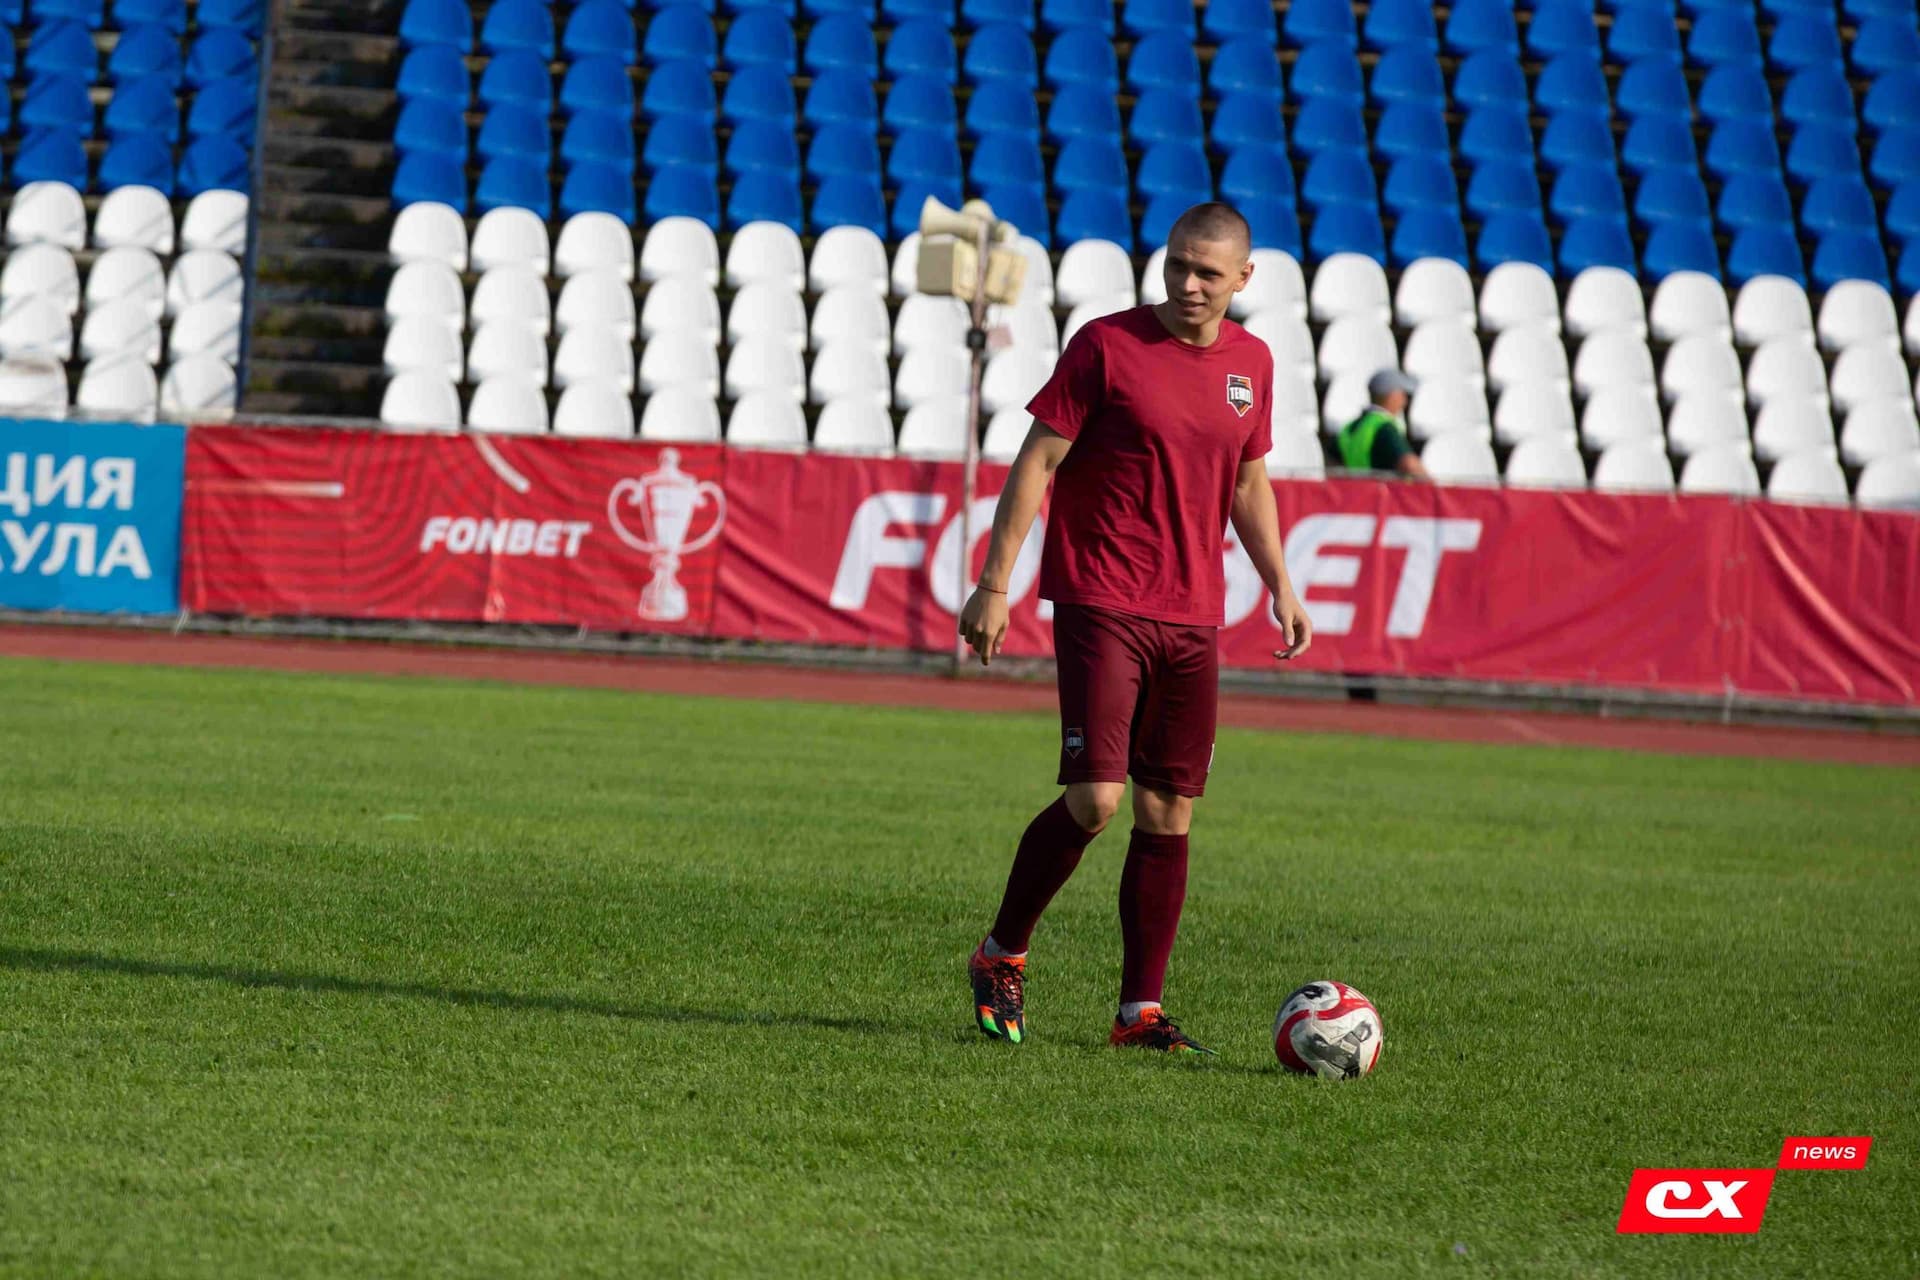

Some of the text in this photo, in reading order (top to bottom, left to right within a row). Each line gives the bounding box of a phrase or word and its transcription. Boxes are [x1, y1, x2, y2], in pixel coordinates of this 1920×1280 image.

[0, 520, 151, 579] УЛА
[420, 516, 593, 558] FONBET
[829, 490, 1482, 639] FOET
